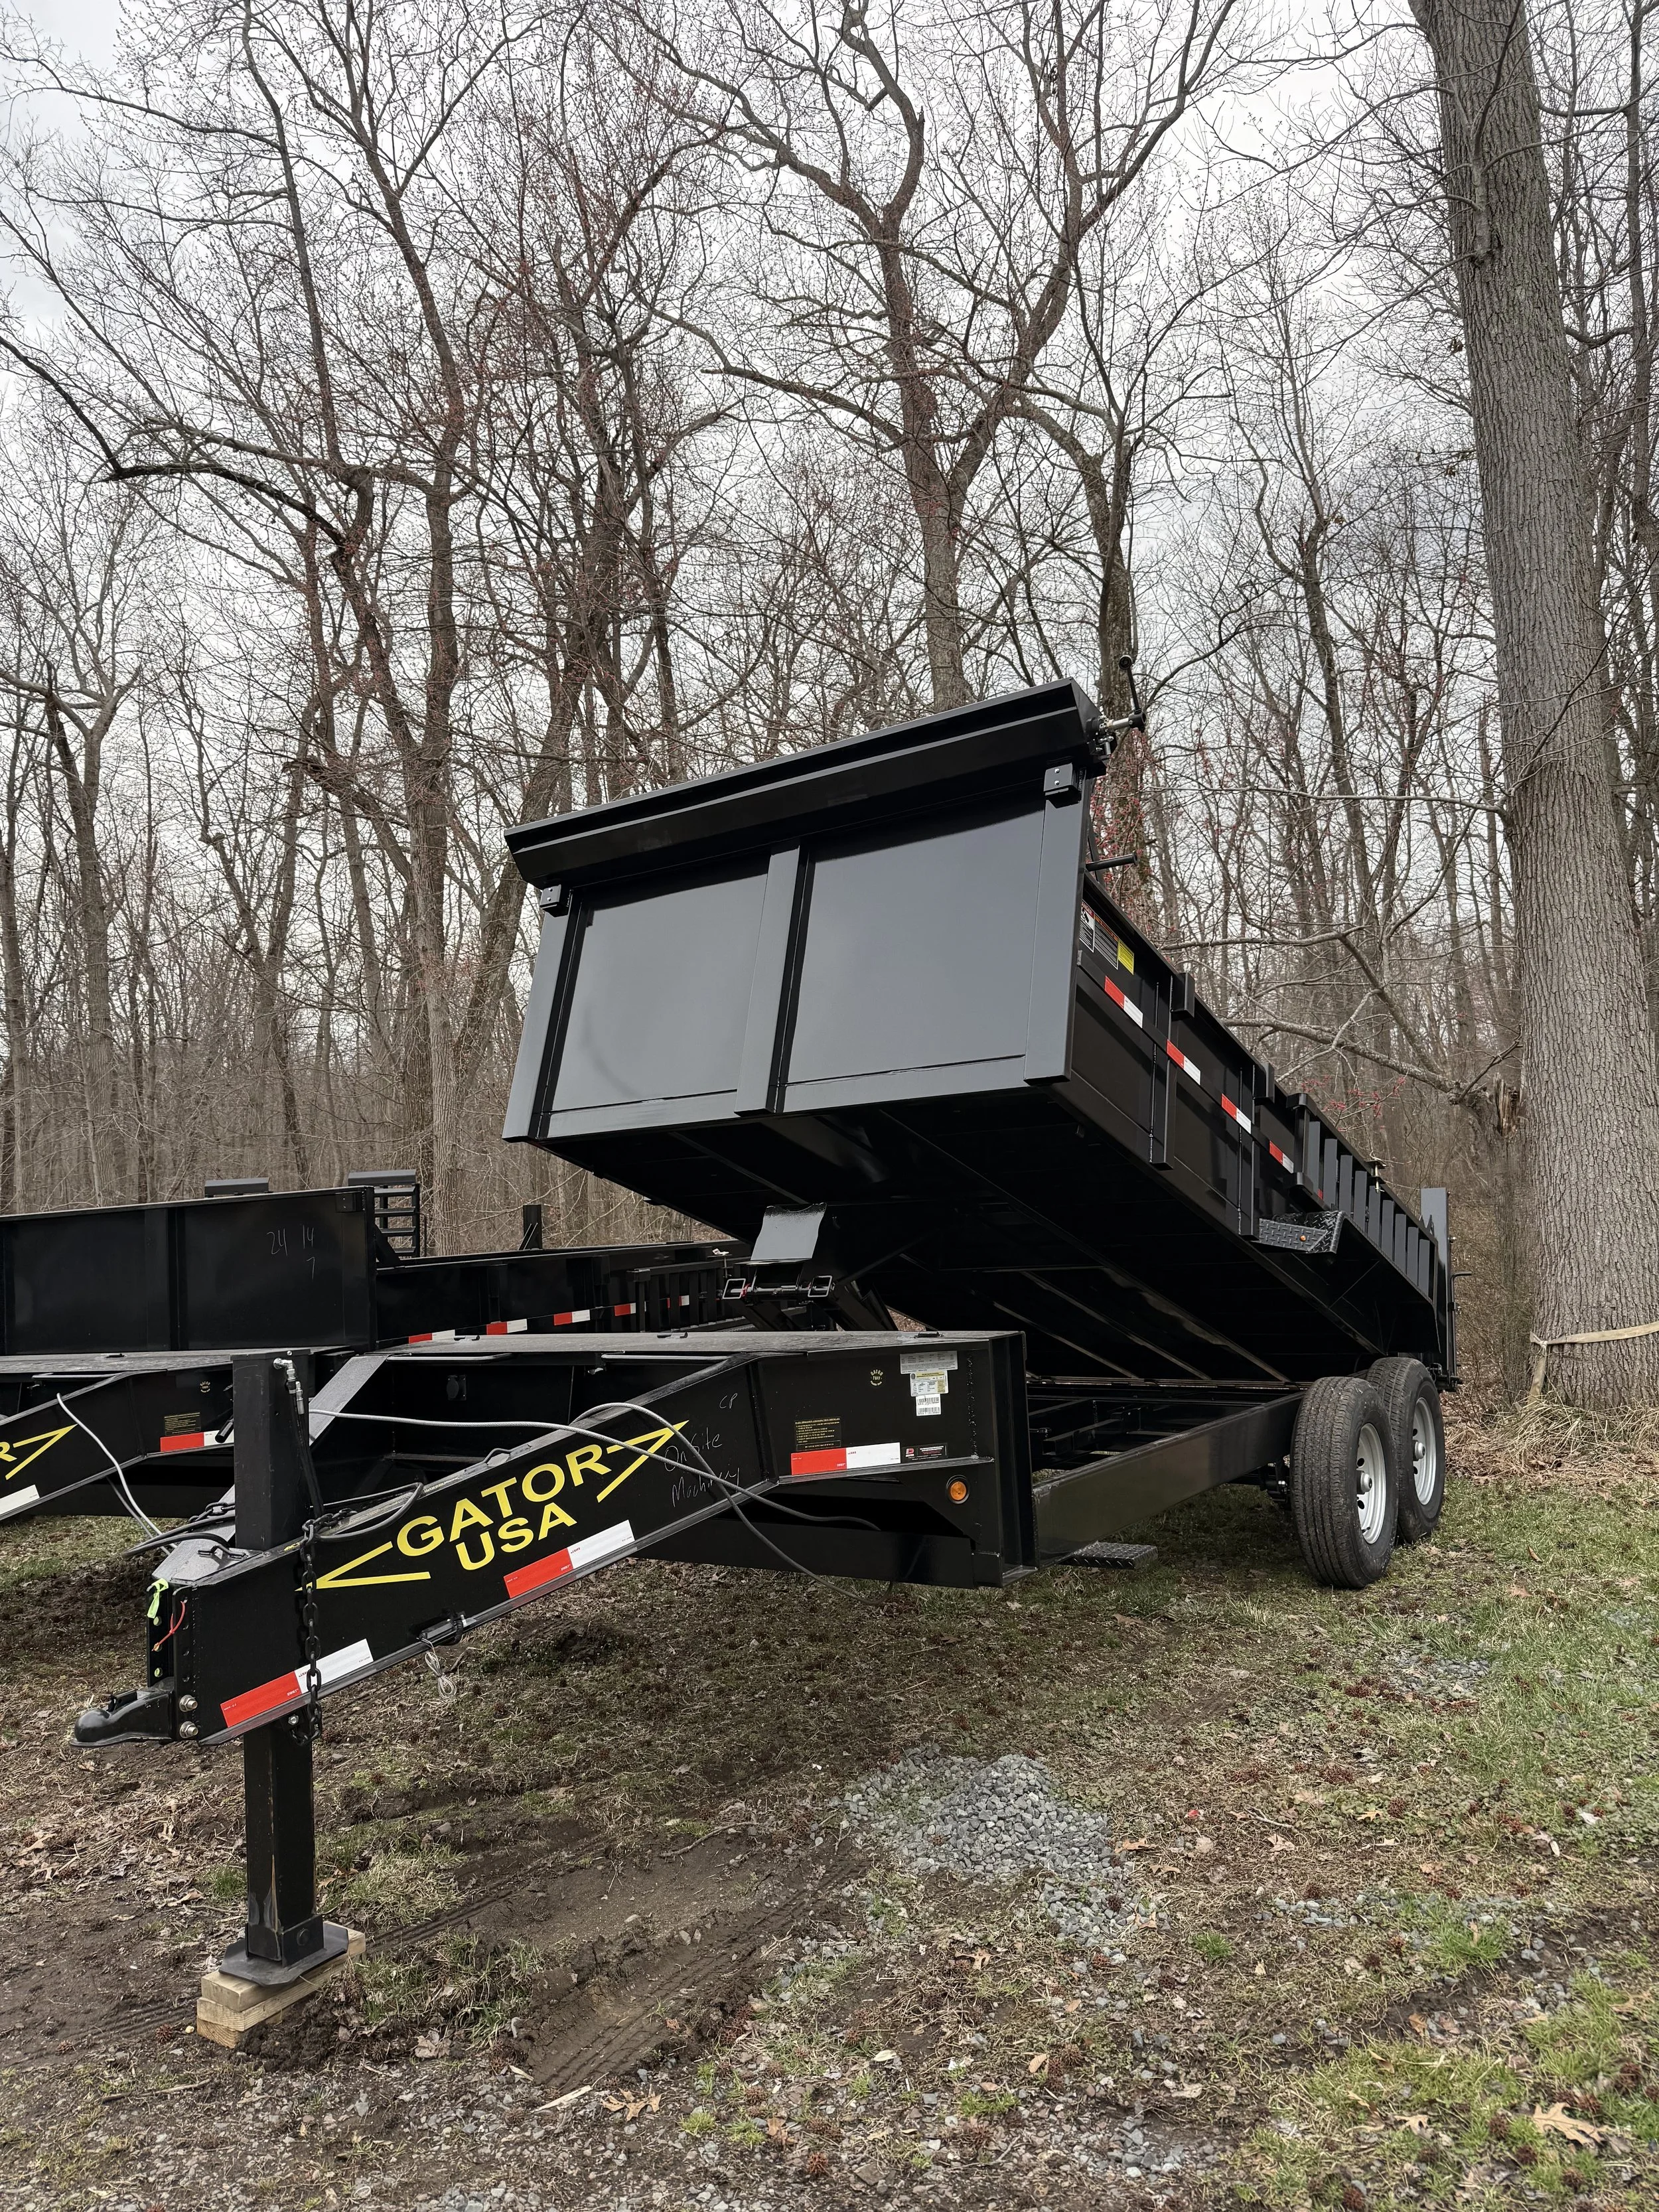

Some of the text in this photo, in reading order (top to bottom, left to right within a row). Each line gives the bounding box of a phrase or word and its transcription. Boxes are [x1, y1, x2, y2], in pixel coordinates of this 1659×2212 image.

[266, 1224, 315, 1256] 24 14
[719, 1393, 738, 1409] CP
[397, 1444, 612, 1556] GATOR
[672, 1467, 740, 1508] Machiry
[456, 1502, 577, 1570] USA
